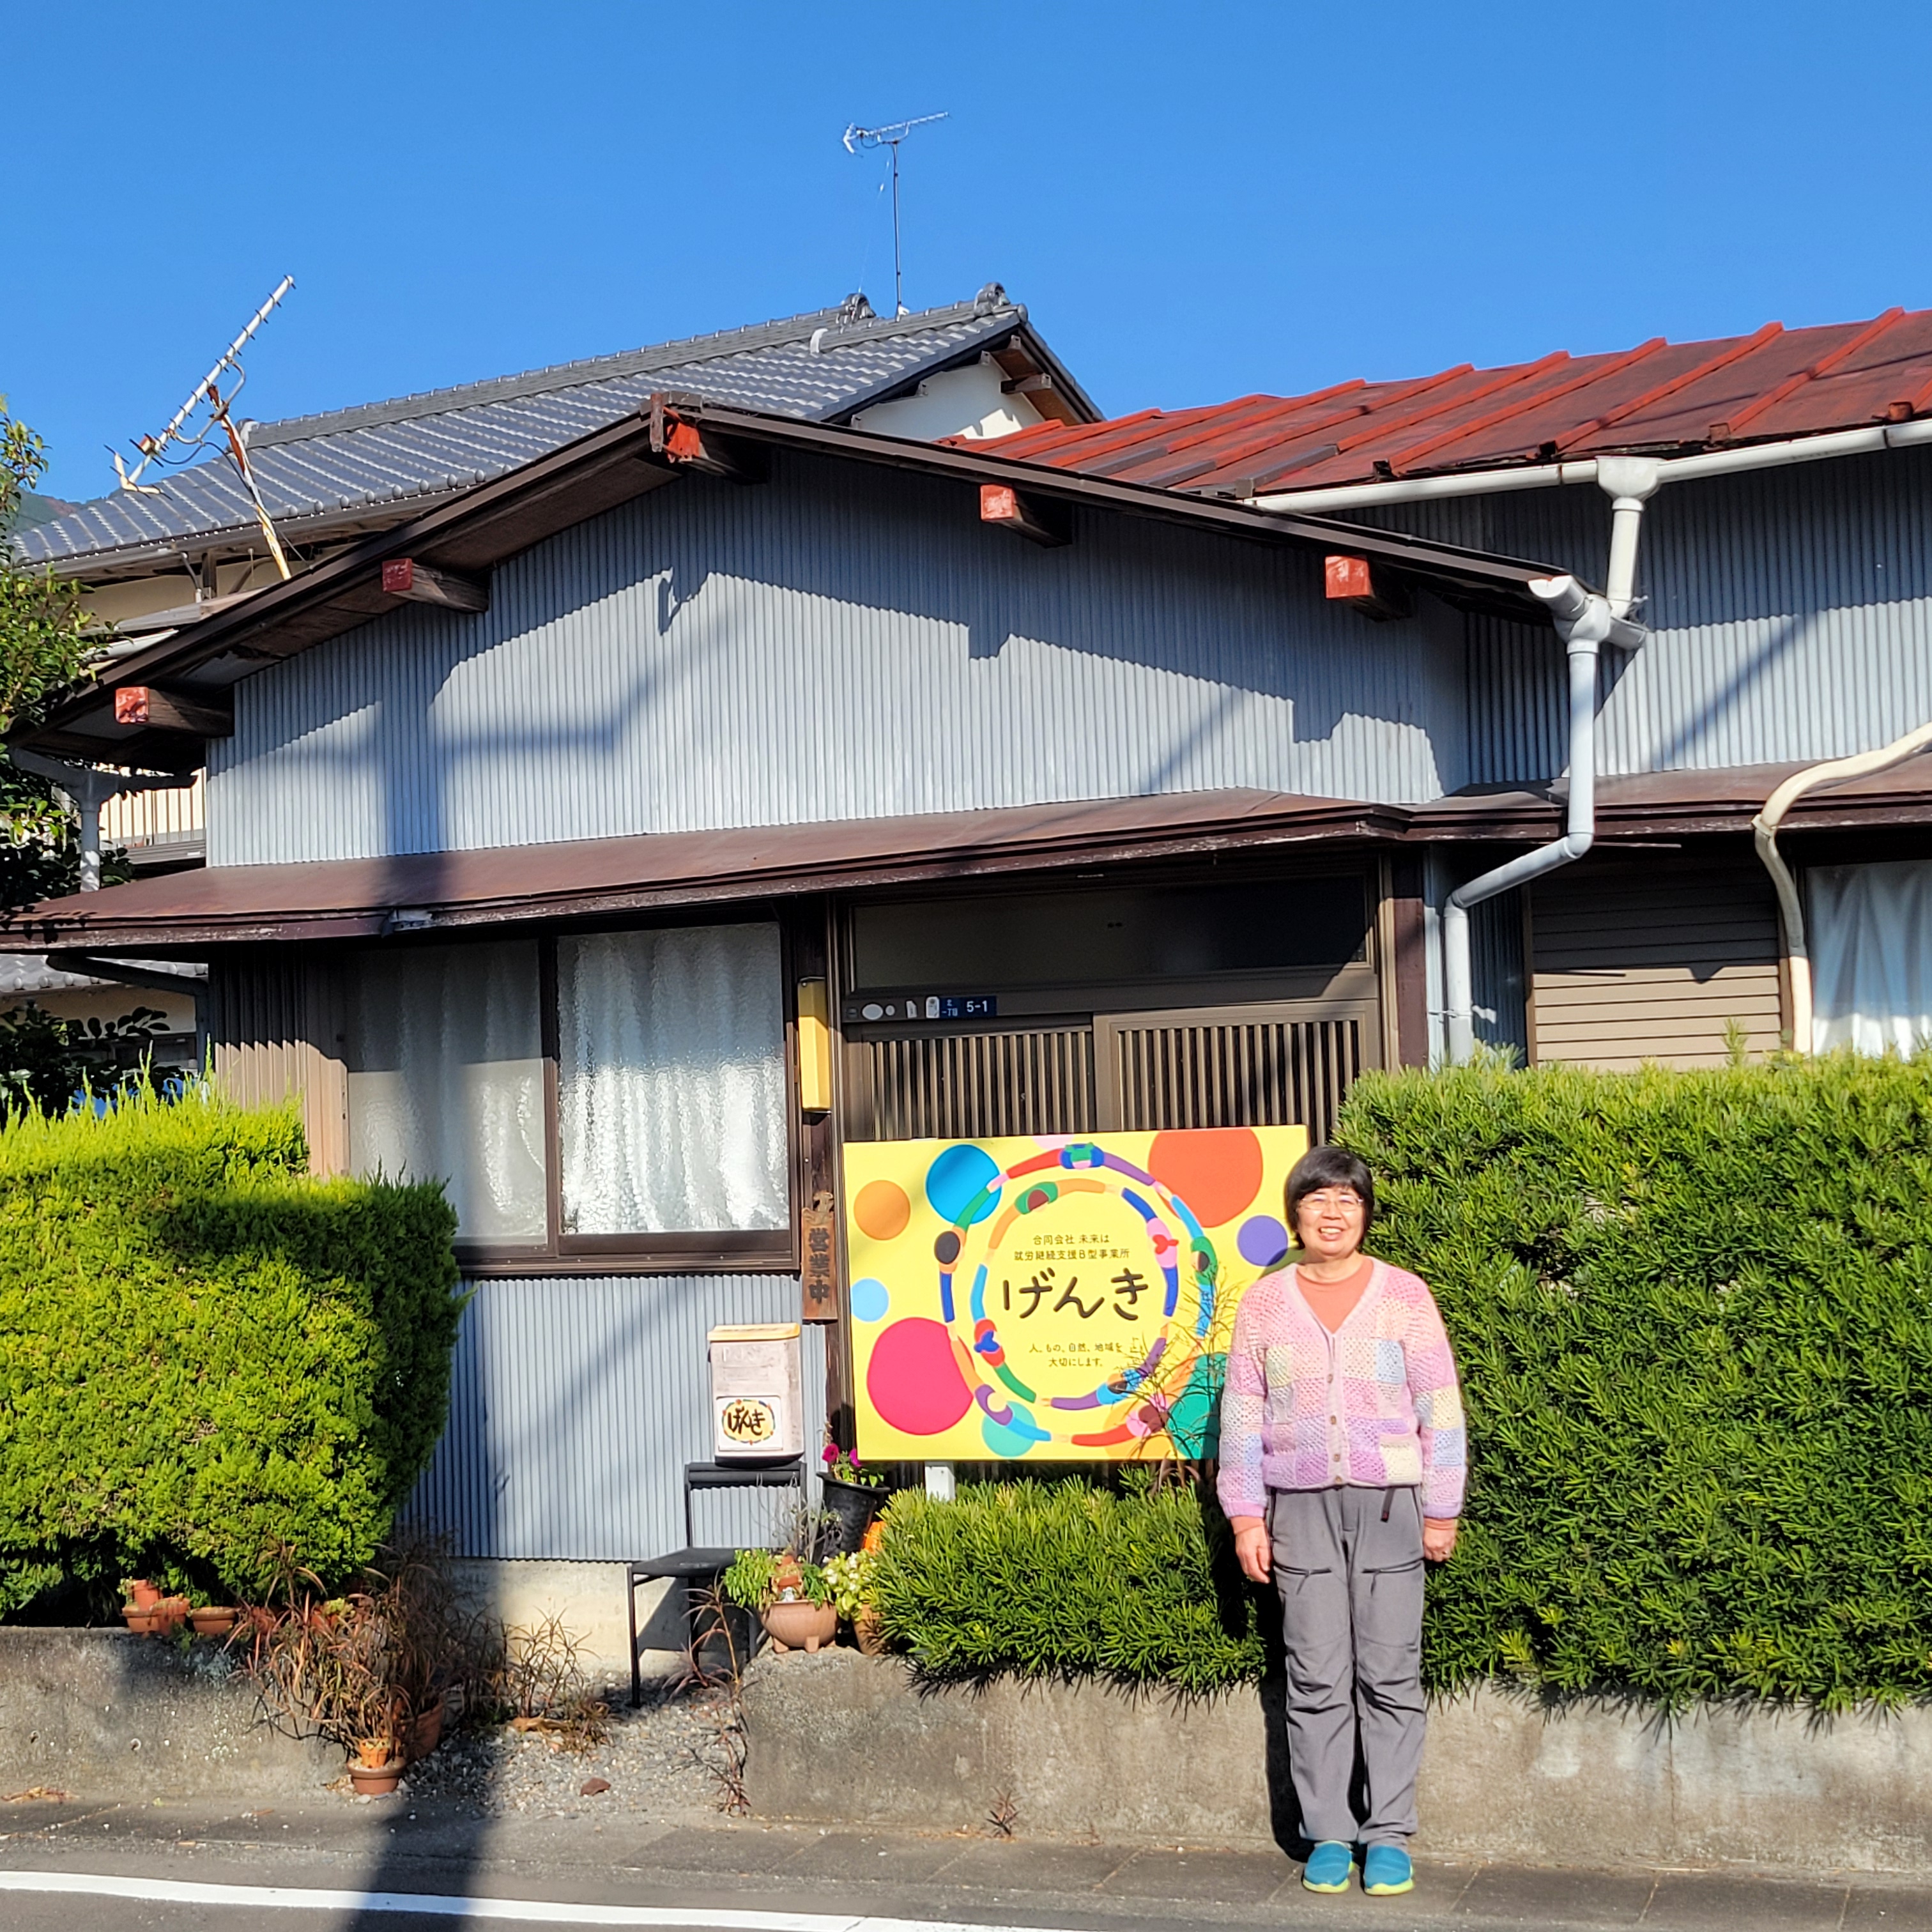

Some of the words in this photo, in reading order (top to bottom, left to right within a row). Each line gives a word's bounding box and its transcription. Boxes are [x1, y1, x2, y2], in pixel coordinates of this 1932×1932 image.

[967, 1000, 988, 1013] 5-1
[1032, 1234, 1075, 1246] 合同会社
[1014, 1248, 1130, 1261] 就労継続支援B型事業所
[808, 1227, 830, 1305] 営業中
[1002, 1266, 1149, 1321] げんき
[727, 1406, 766, 1436] げんき
